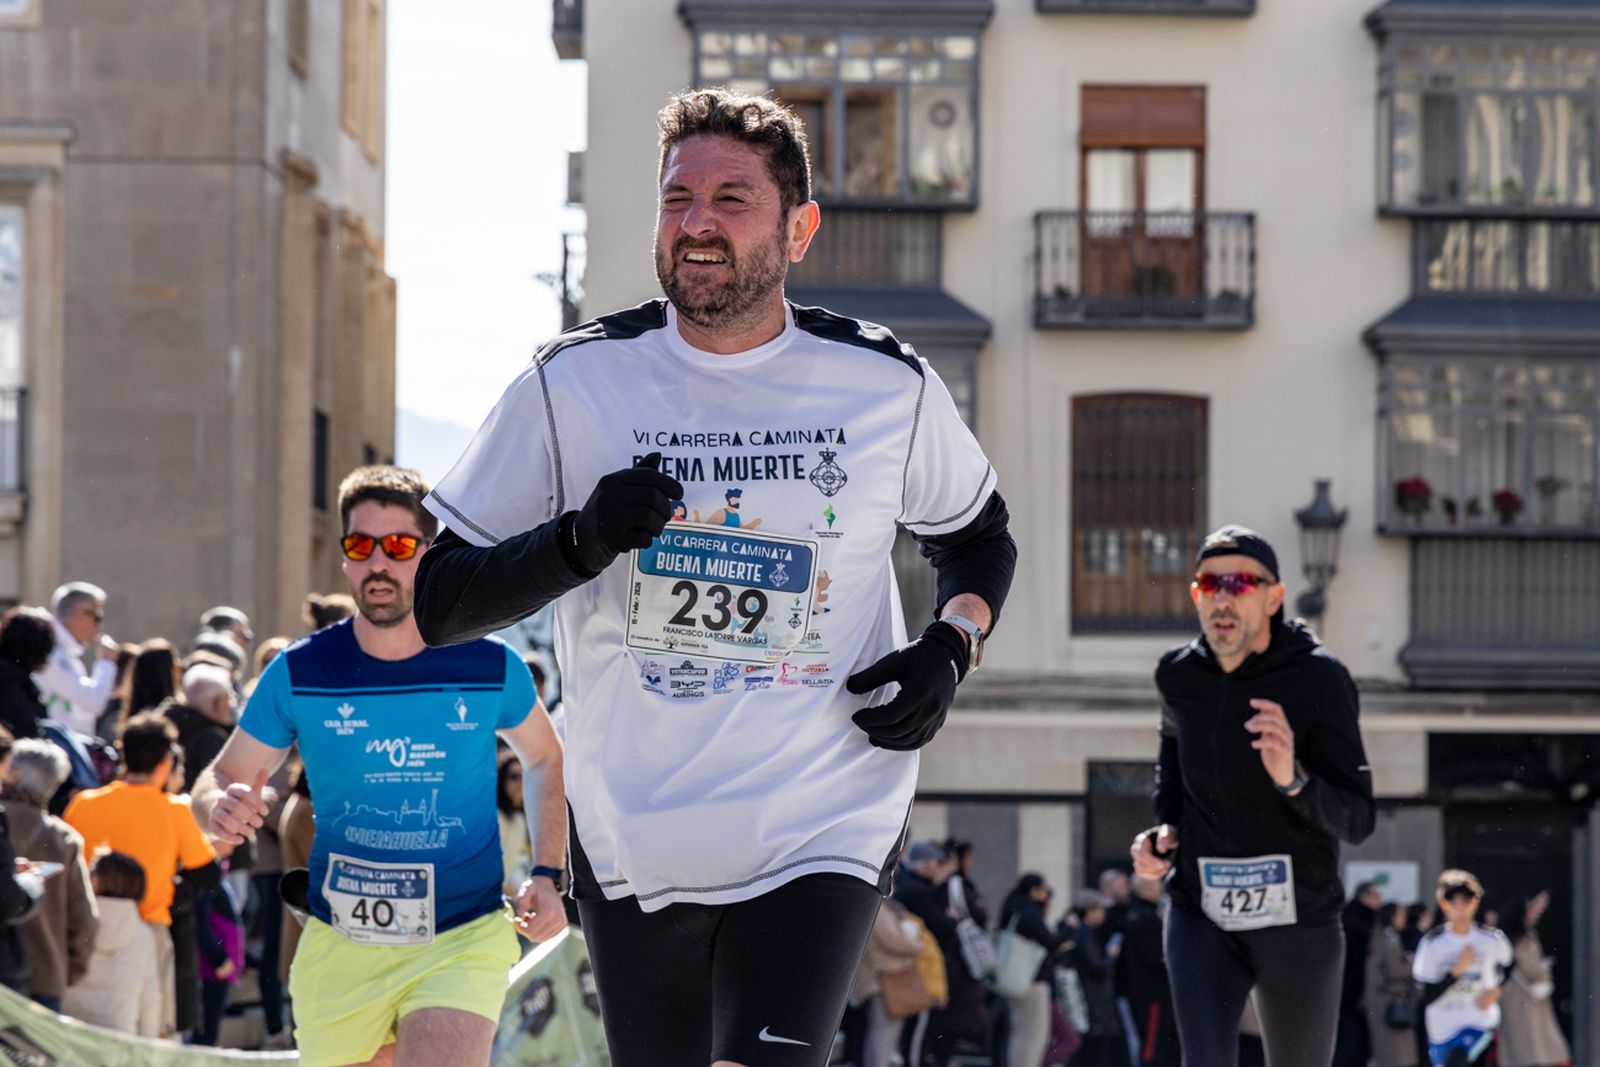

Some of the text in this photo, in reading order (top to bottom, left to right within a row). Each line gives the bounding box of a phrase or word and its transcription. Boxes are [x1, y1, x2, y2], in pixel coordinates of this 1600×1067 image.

[633, 427, 847, 448] VI CARRERA CAMINATA
[632, 454, 806, 483] ENA MUERTE
[659, 534, 793, 561] VI CARRERA CAMINATA
[656, 552, 763, 583] BUENA MUERTE
[668, 580, 769, 635] 239
[662, 625, 704, 638] FRANCISCO
[736, 634, 768, 646] VARGAS
[361, 880, 398, 897] MUERTE
[1220, 888, 1267, 913] 427
[351, 898, 394, 928] 40
